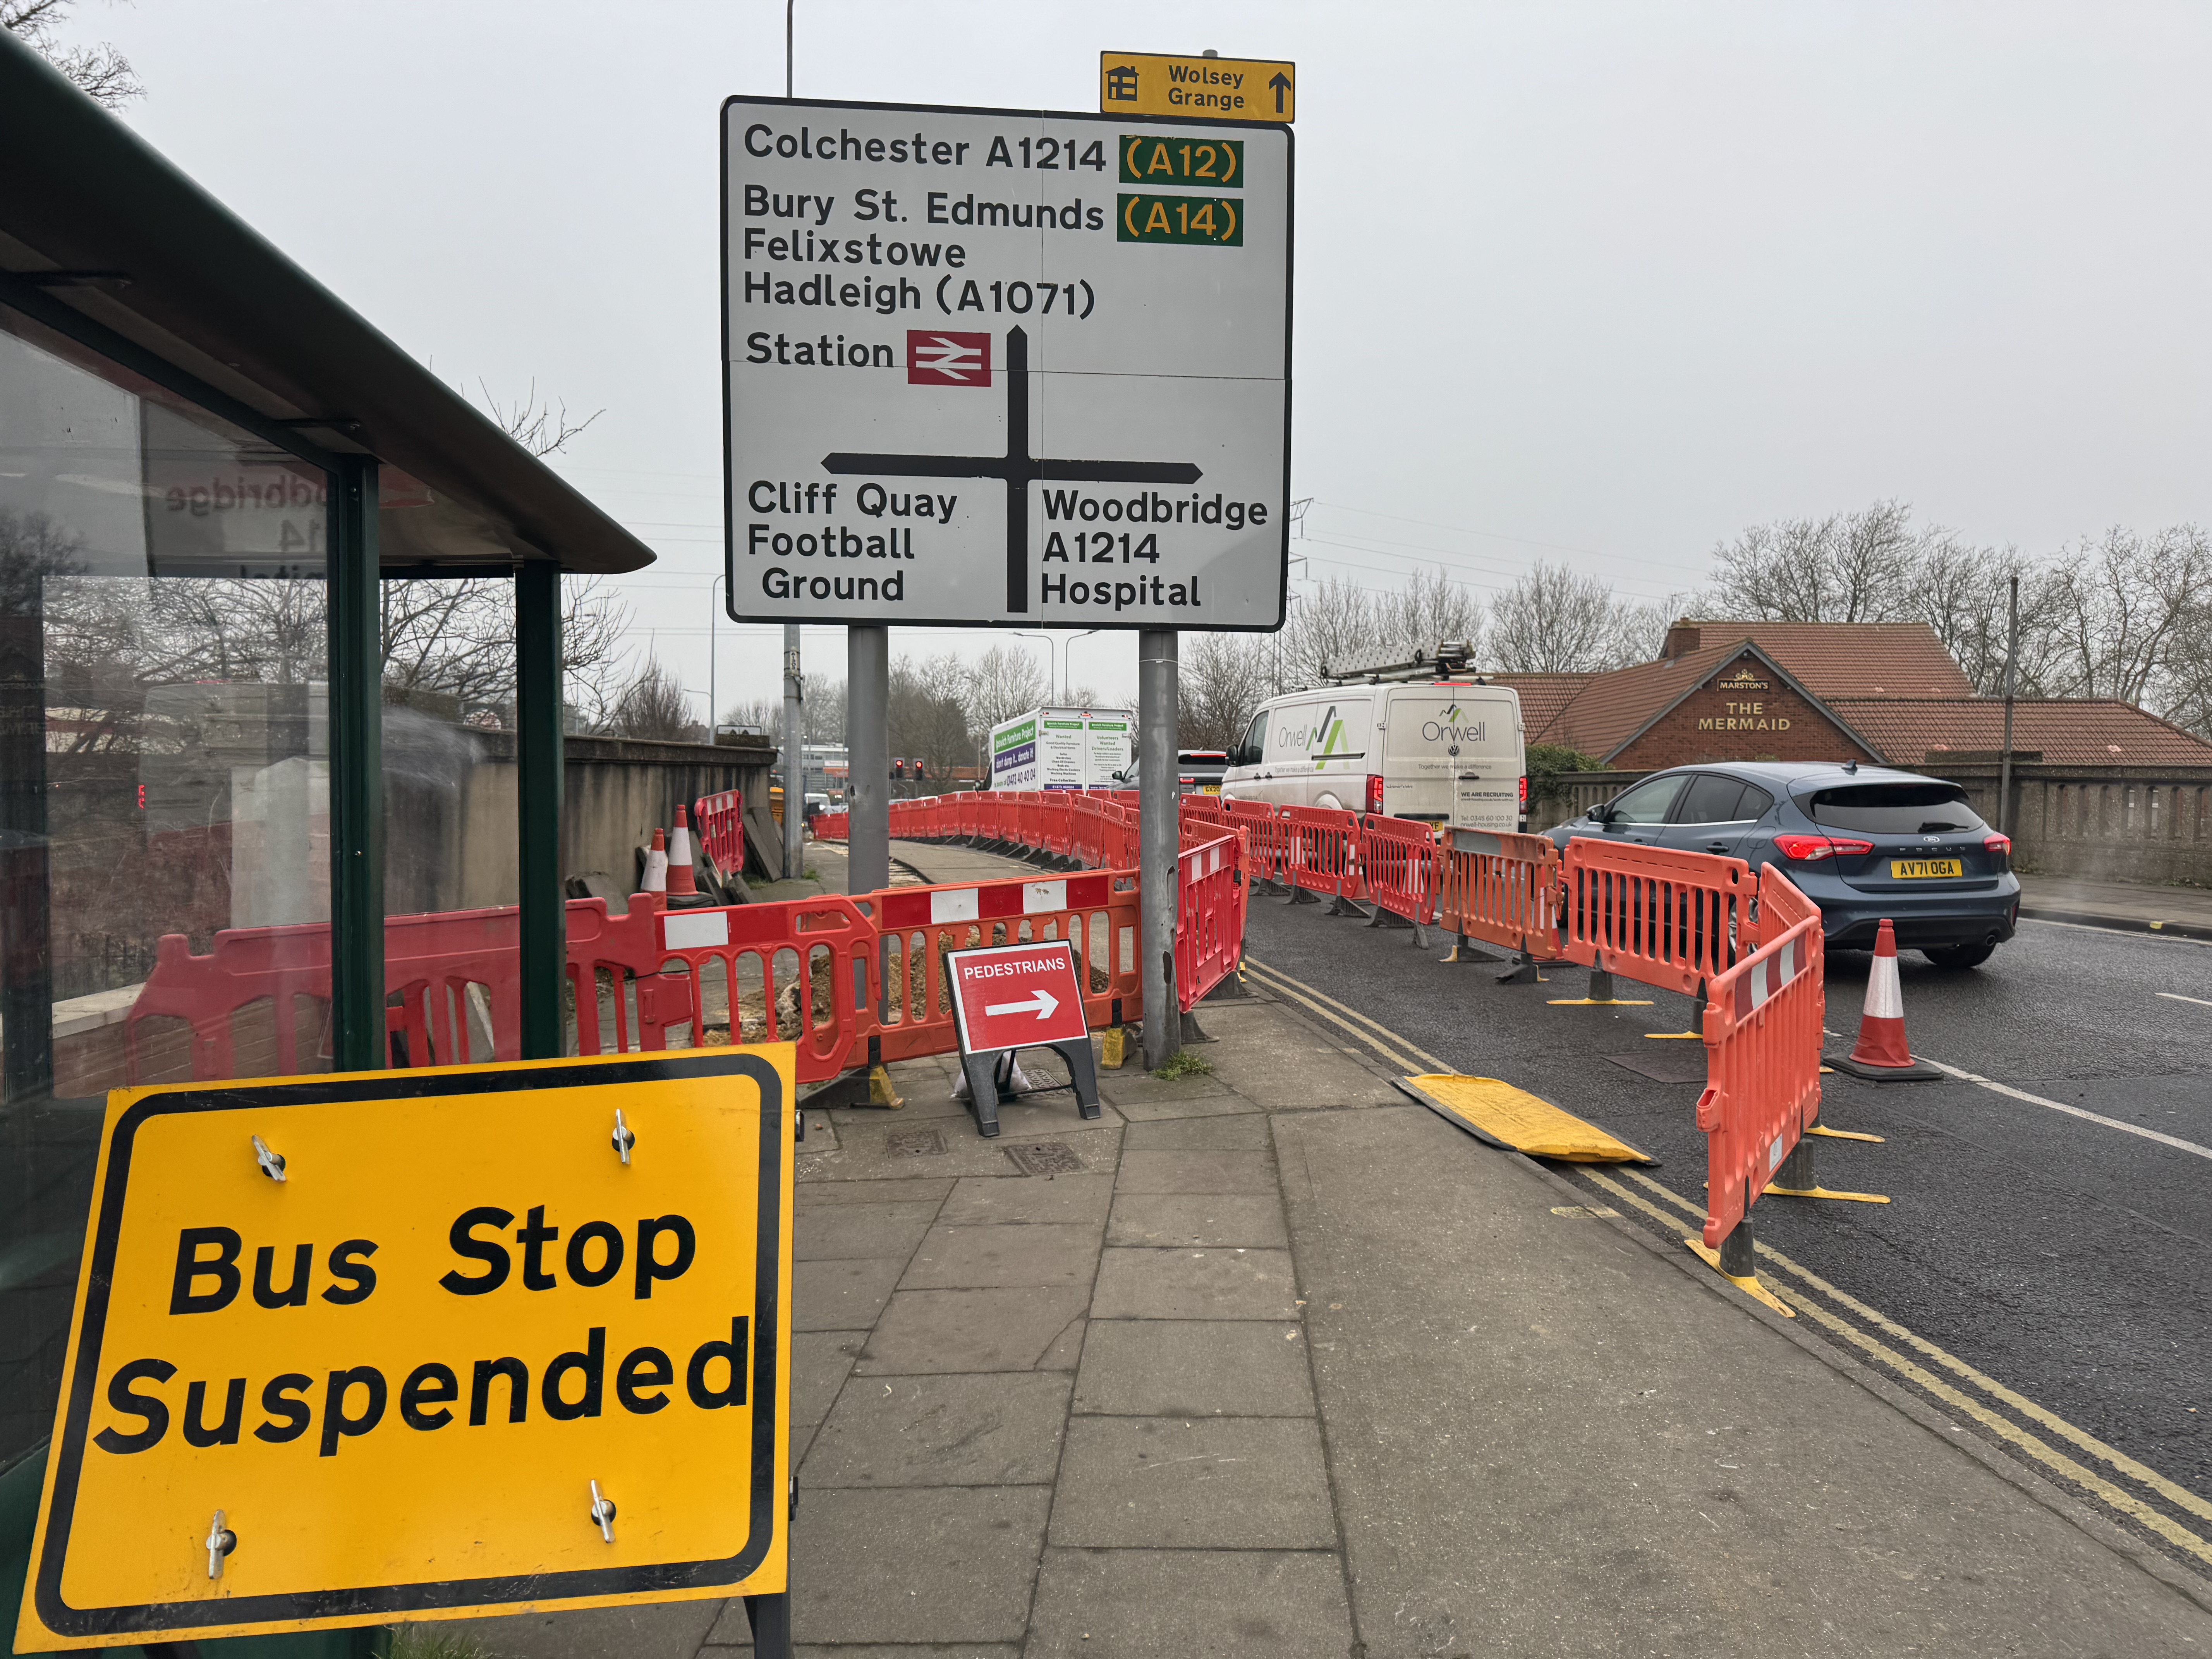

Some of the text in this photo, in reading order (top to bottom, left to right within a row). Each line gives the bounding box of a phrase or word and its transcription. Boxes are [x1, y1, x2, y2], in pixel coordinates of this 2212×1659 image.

[1169, 65, 1243, 89] Wolsey
[1168, 89, 1244, 111] Grange
[745, 124, 1235, 182] Colchester A1214 (A12)
[745, 185, 1235, 240] Bury St. Edmunds (A14)
[745, 228, 965, 268] Felixstowe
[745, 271, 1094, 320] Hadleigh (A1071)
[746, 332, 894, 368] Station
[749, 481, 957, 524] Cliff Quay
[1042, 489, 1267, 530] Woodbridge
[749, 524, 914, 559] Football
[1042, 532, 1159, 563] A1214
[763, 567, 903, 601] Ground
[1042, 573, 1200, 611] Hospital
[1698, 718, 1790, 730] MERMAID
[1726, 702, 1763, 714] THE
[1279, 724, 1307, 747] Orwell
[1422, 721, 1485, 741] Orwell
[1018, 772, 1022, 783] 40
[1024, 770, 1029, 782] 40
[1901, 861, 1954, 875] AV71 OGA
[964, 957, 1065, 980] PEDESTRIANS
[169, 1205, 695, 1315] Bus Stop
[93, 1316, 749, 1457] Suspended
